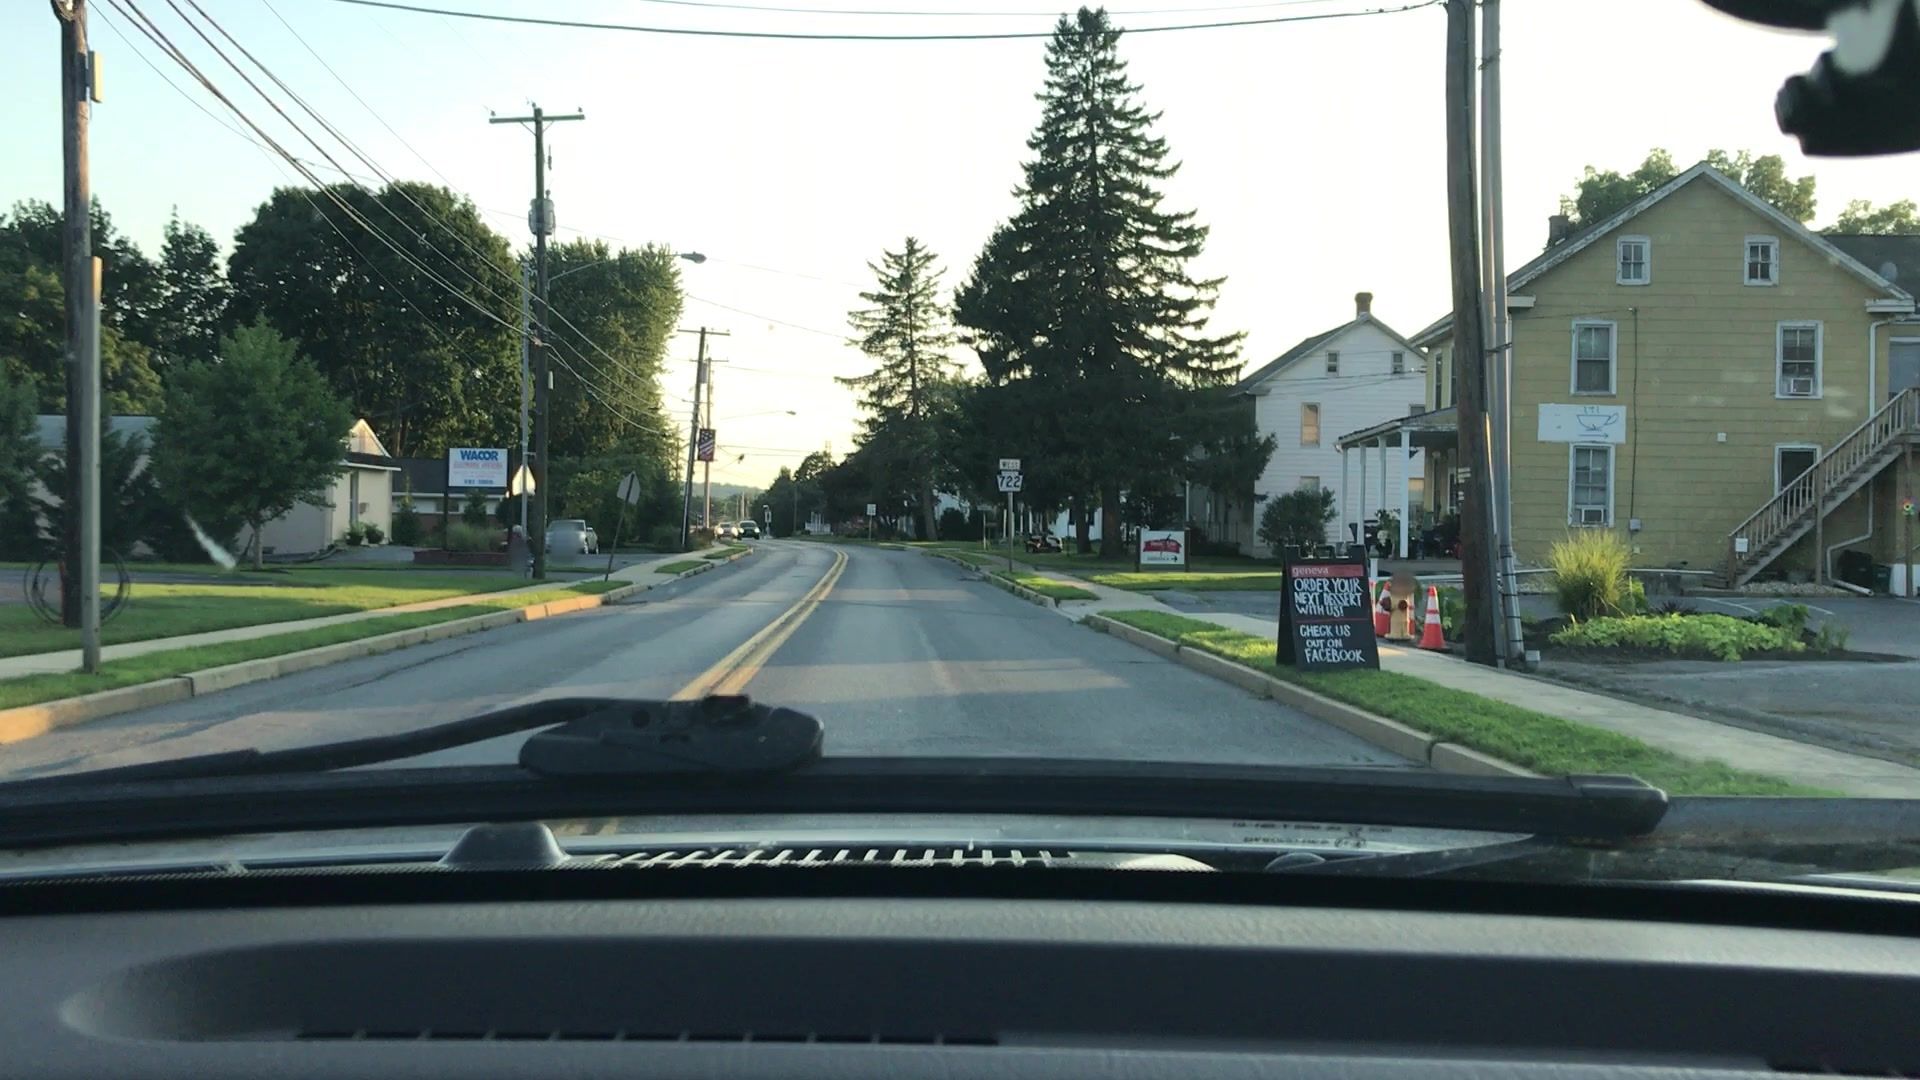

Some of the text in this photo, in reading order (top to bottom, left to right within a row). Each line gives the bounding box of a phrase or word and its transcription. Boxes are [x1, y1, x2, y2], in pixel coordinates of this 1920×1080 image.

[999, 475, 1020, 488] 722
[1292, 567, 1328, 577] geneva
[1294, 578, 1363, 593] ORDER YOUR
[1294, 592, 1362, 608] NEXT DESSERT
[1296, 604, 1344, 617] WITH US!
[1300, 624, 1351, 637] CHECK US
[1306, 639, 1343, 650] OUT ON
[1305, 648, 1366, 663] FACEBOOK
